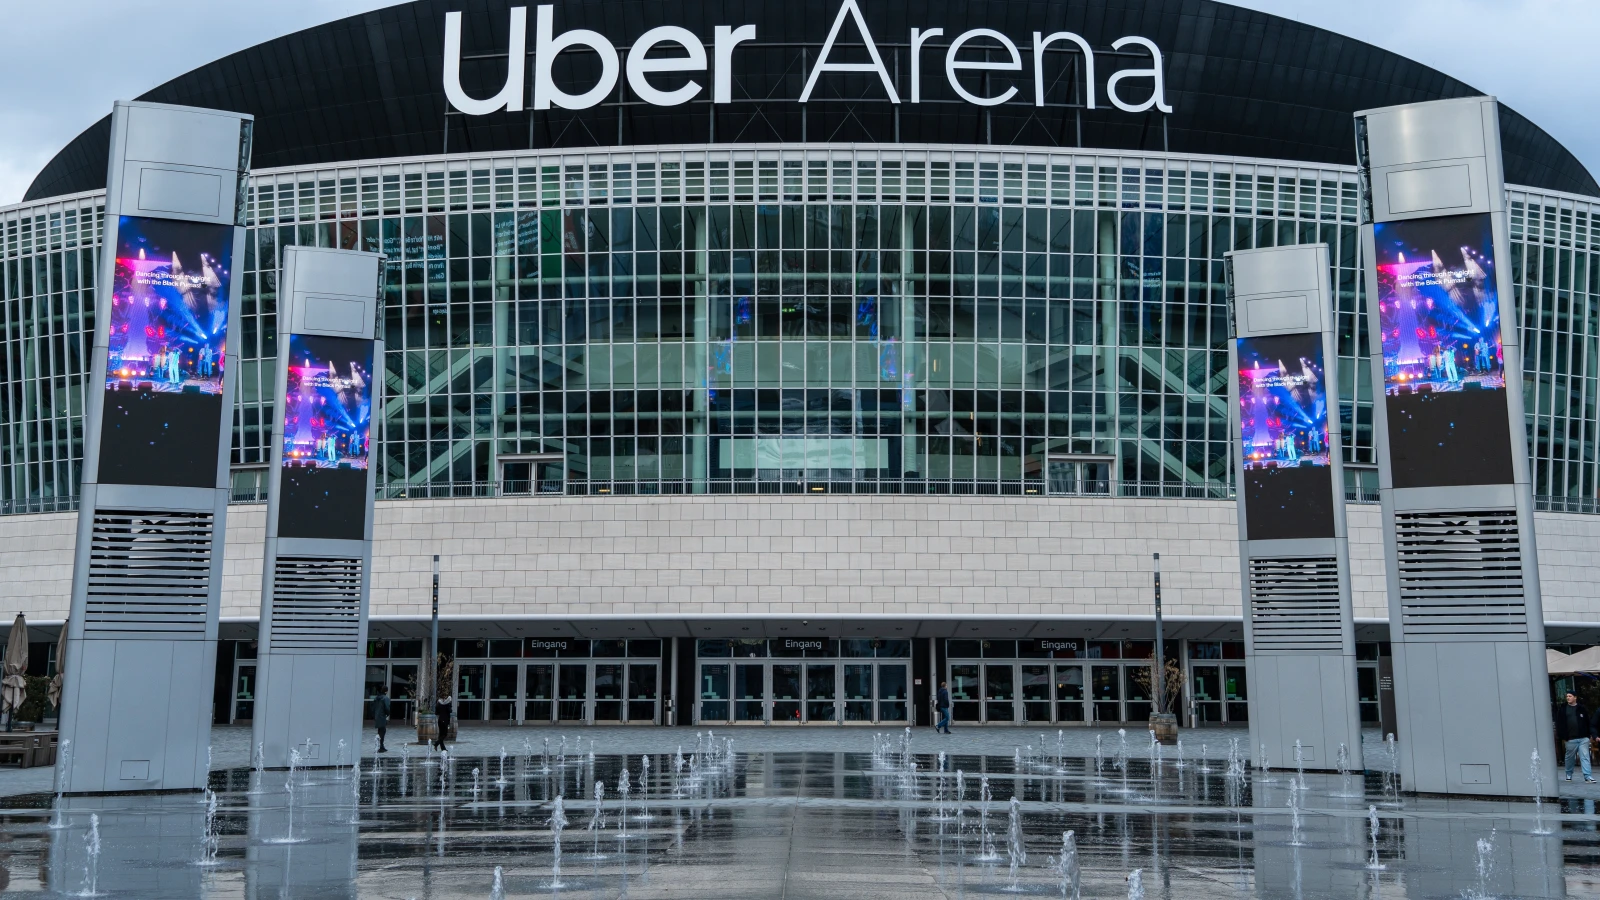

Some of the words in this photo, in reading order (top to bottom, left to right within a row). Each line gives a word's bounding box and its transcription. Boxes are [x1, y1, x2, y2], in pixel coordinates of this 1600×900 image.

[443, 4, 756, 116] Uber
[799, 0, 1173, 113] Arena
[135, 271, 160, 279] Dancing
[160, 273, 184, 281] through
[1398, 273, 1422, 281] Dancing
[1423, 271, 1447, 279] through
[531, 639, 567, 650] Eingang
[785, 639, 822, 650] Eingang
[1041, 640, 1077, 651] Eingang
